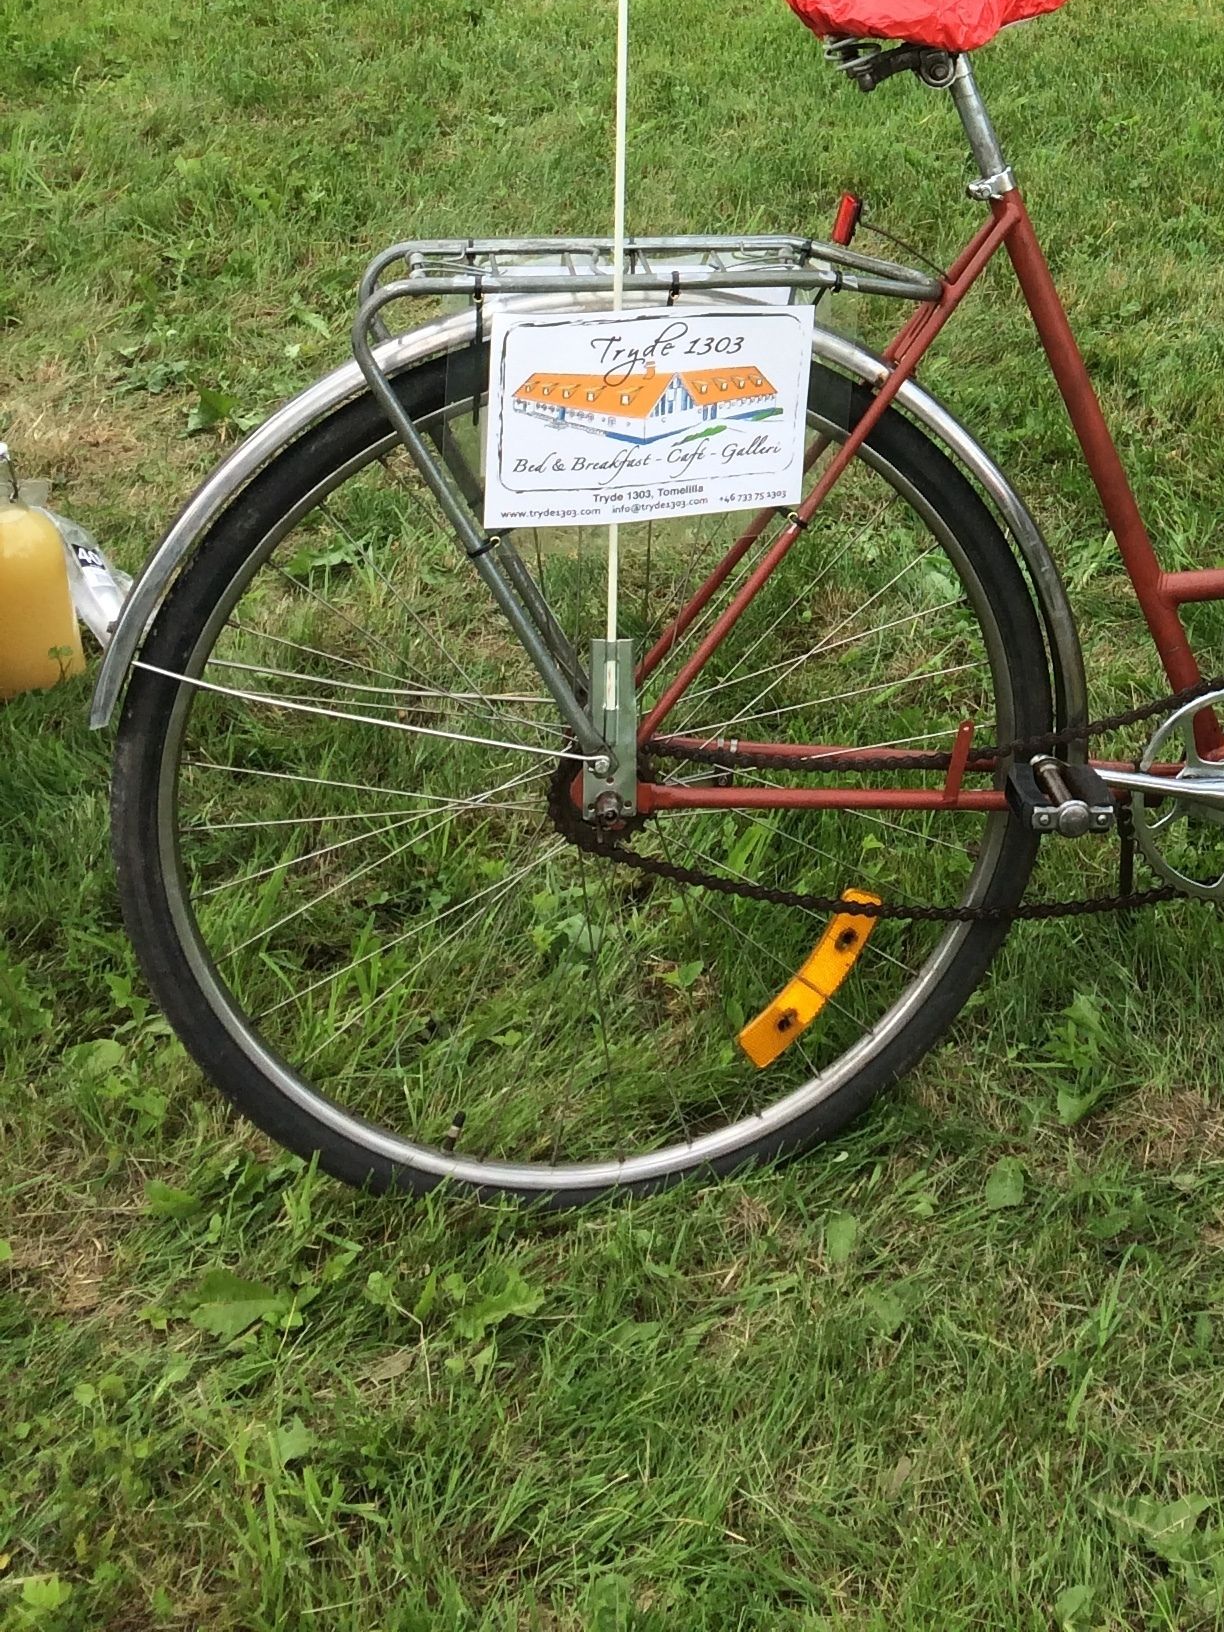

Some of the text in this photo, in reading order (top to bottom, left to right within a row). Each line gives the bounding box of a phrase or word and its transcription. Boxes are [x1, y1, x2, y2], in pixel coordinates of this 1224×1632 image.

[591, 322, 745, 387] Tryde 1303
[513, 452, 557, 473] Bed
[552, 458, 565, 471] &
[571, 445, 652, 485] Breakfast
[667, 439, 707, 479] Café
[721, 435, 782, 459] Galleri
[501, 489, 787, 519] www.tryde1303.com info@tryde1303.com +46 733 75 1303
[593, 484, 704, 505] Tryde 1303, Tomelilla
